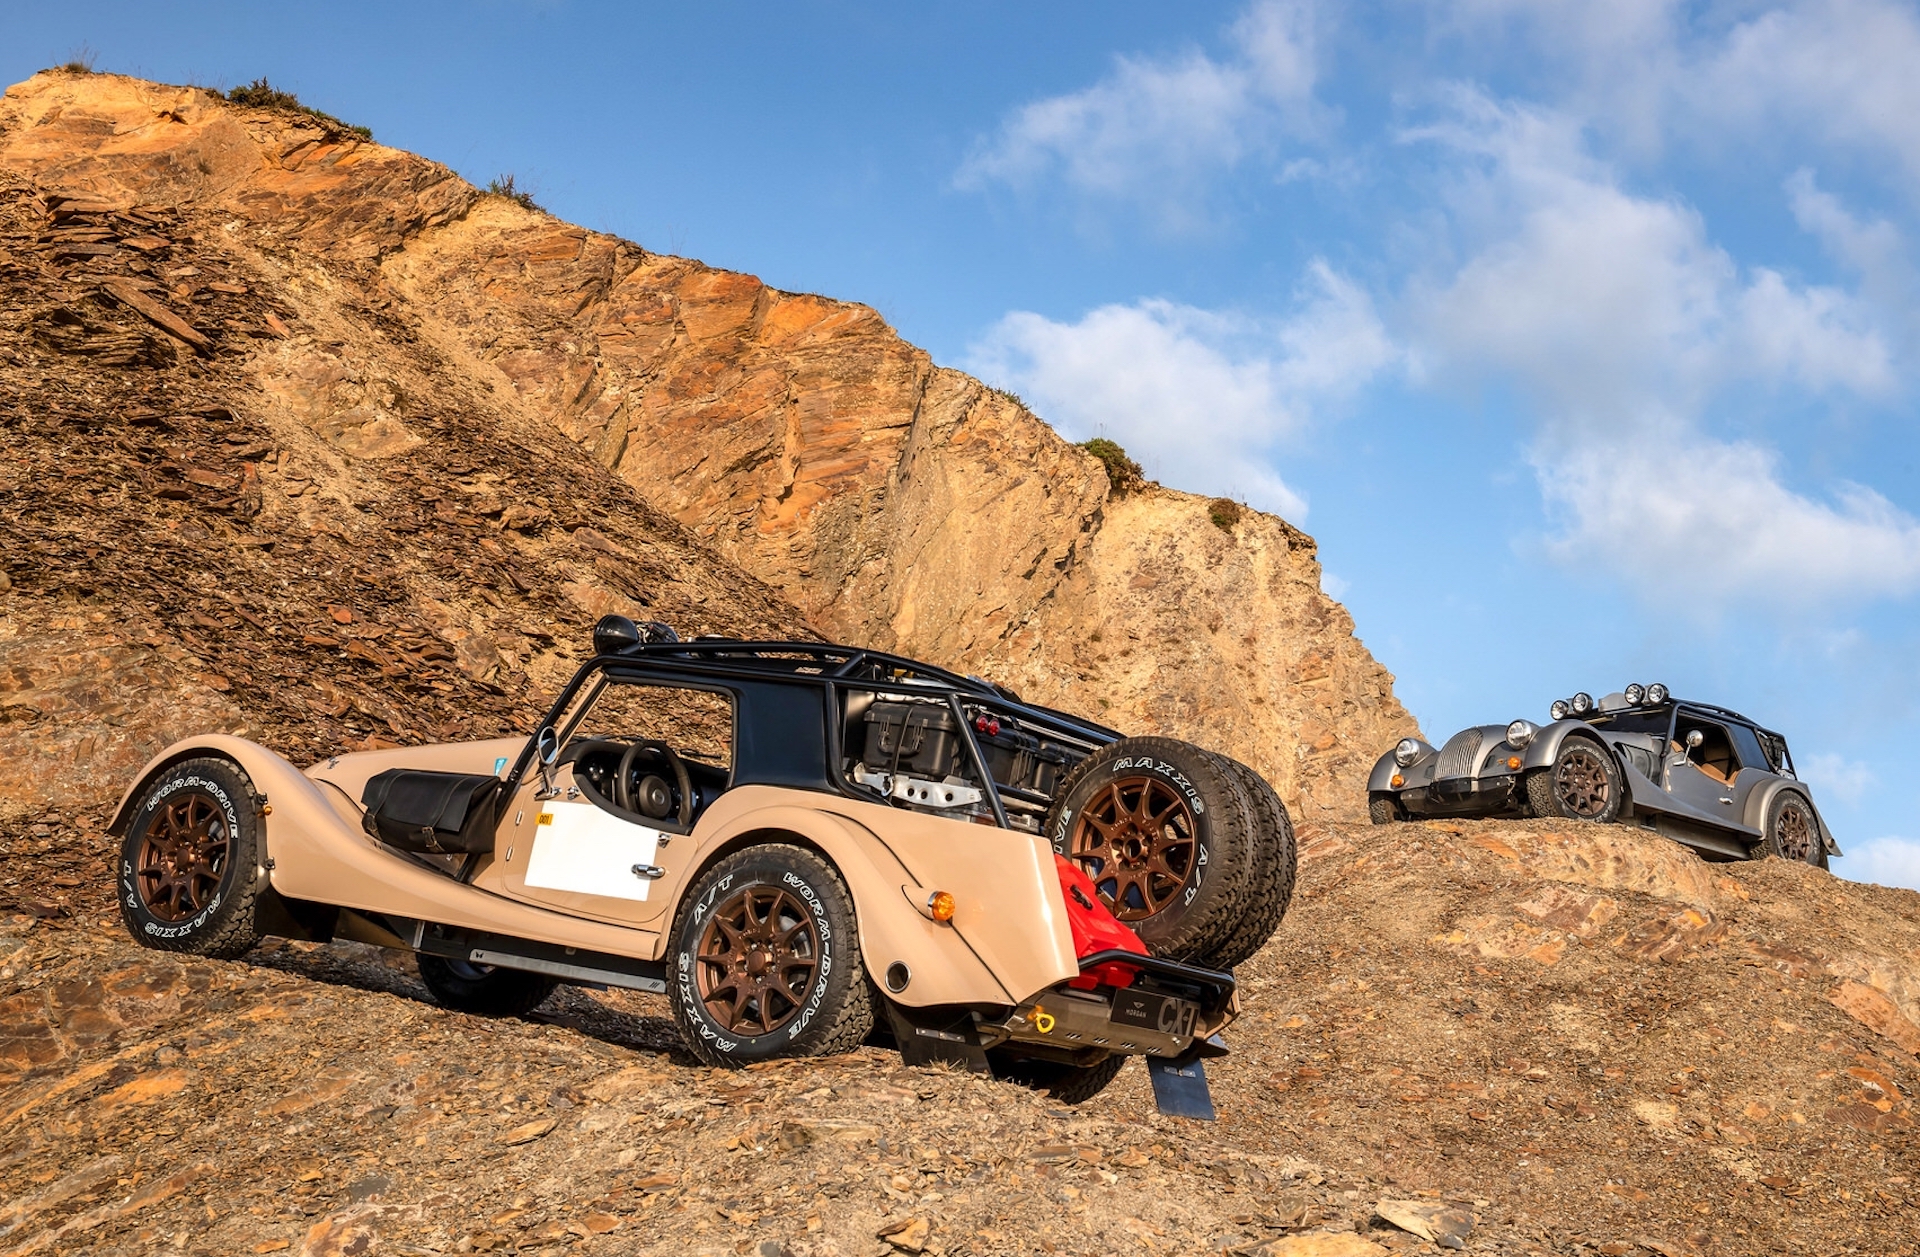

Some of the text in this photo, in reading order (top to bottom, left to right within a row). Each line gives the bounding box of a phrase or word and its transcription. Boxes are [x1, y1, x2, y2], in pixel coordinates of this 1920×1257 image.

[147, 776, 239, 839] WORM-DRIVE
[1112, 756, 1204, 815] MAXXIS
[145, 892, 222, 938] MAXXIS
[694, 874, 734, 925] A/T
[783, 872, 832, 1040] WORM-DRIVE
[678, 951, 738, 1053] MAXXIS
[1125, 1008, 1147, 1018] MORGAN
[1157, 997, 1201, 1037] CXT
